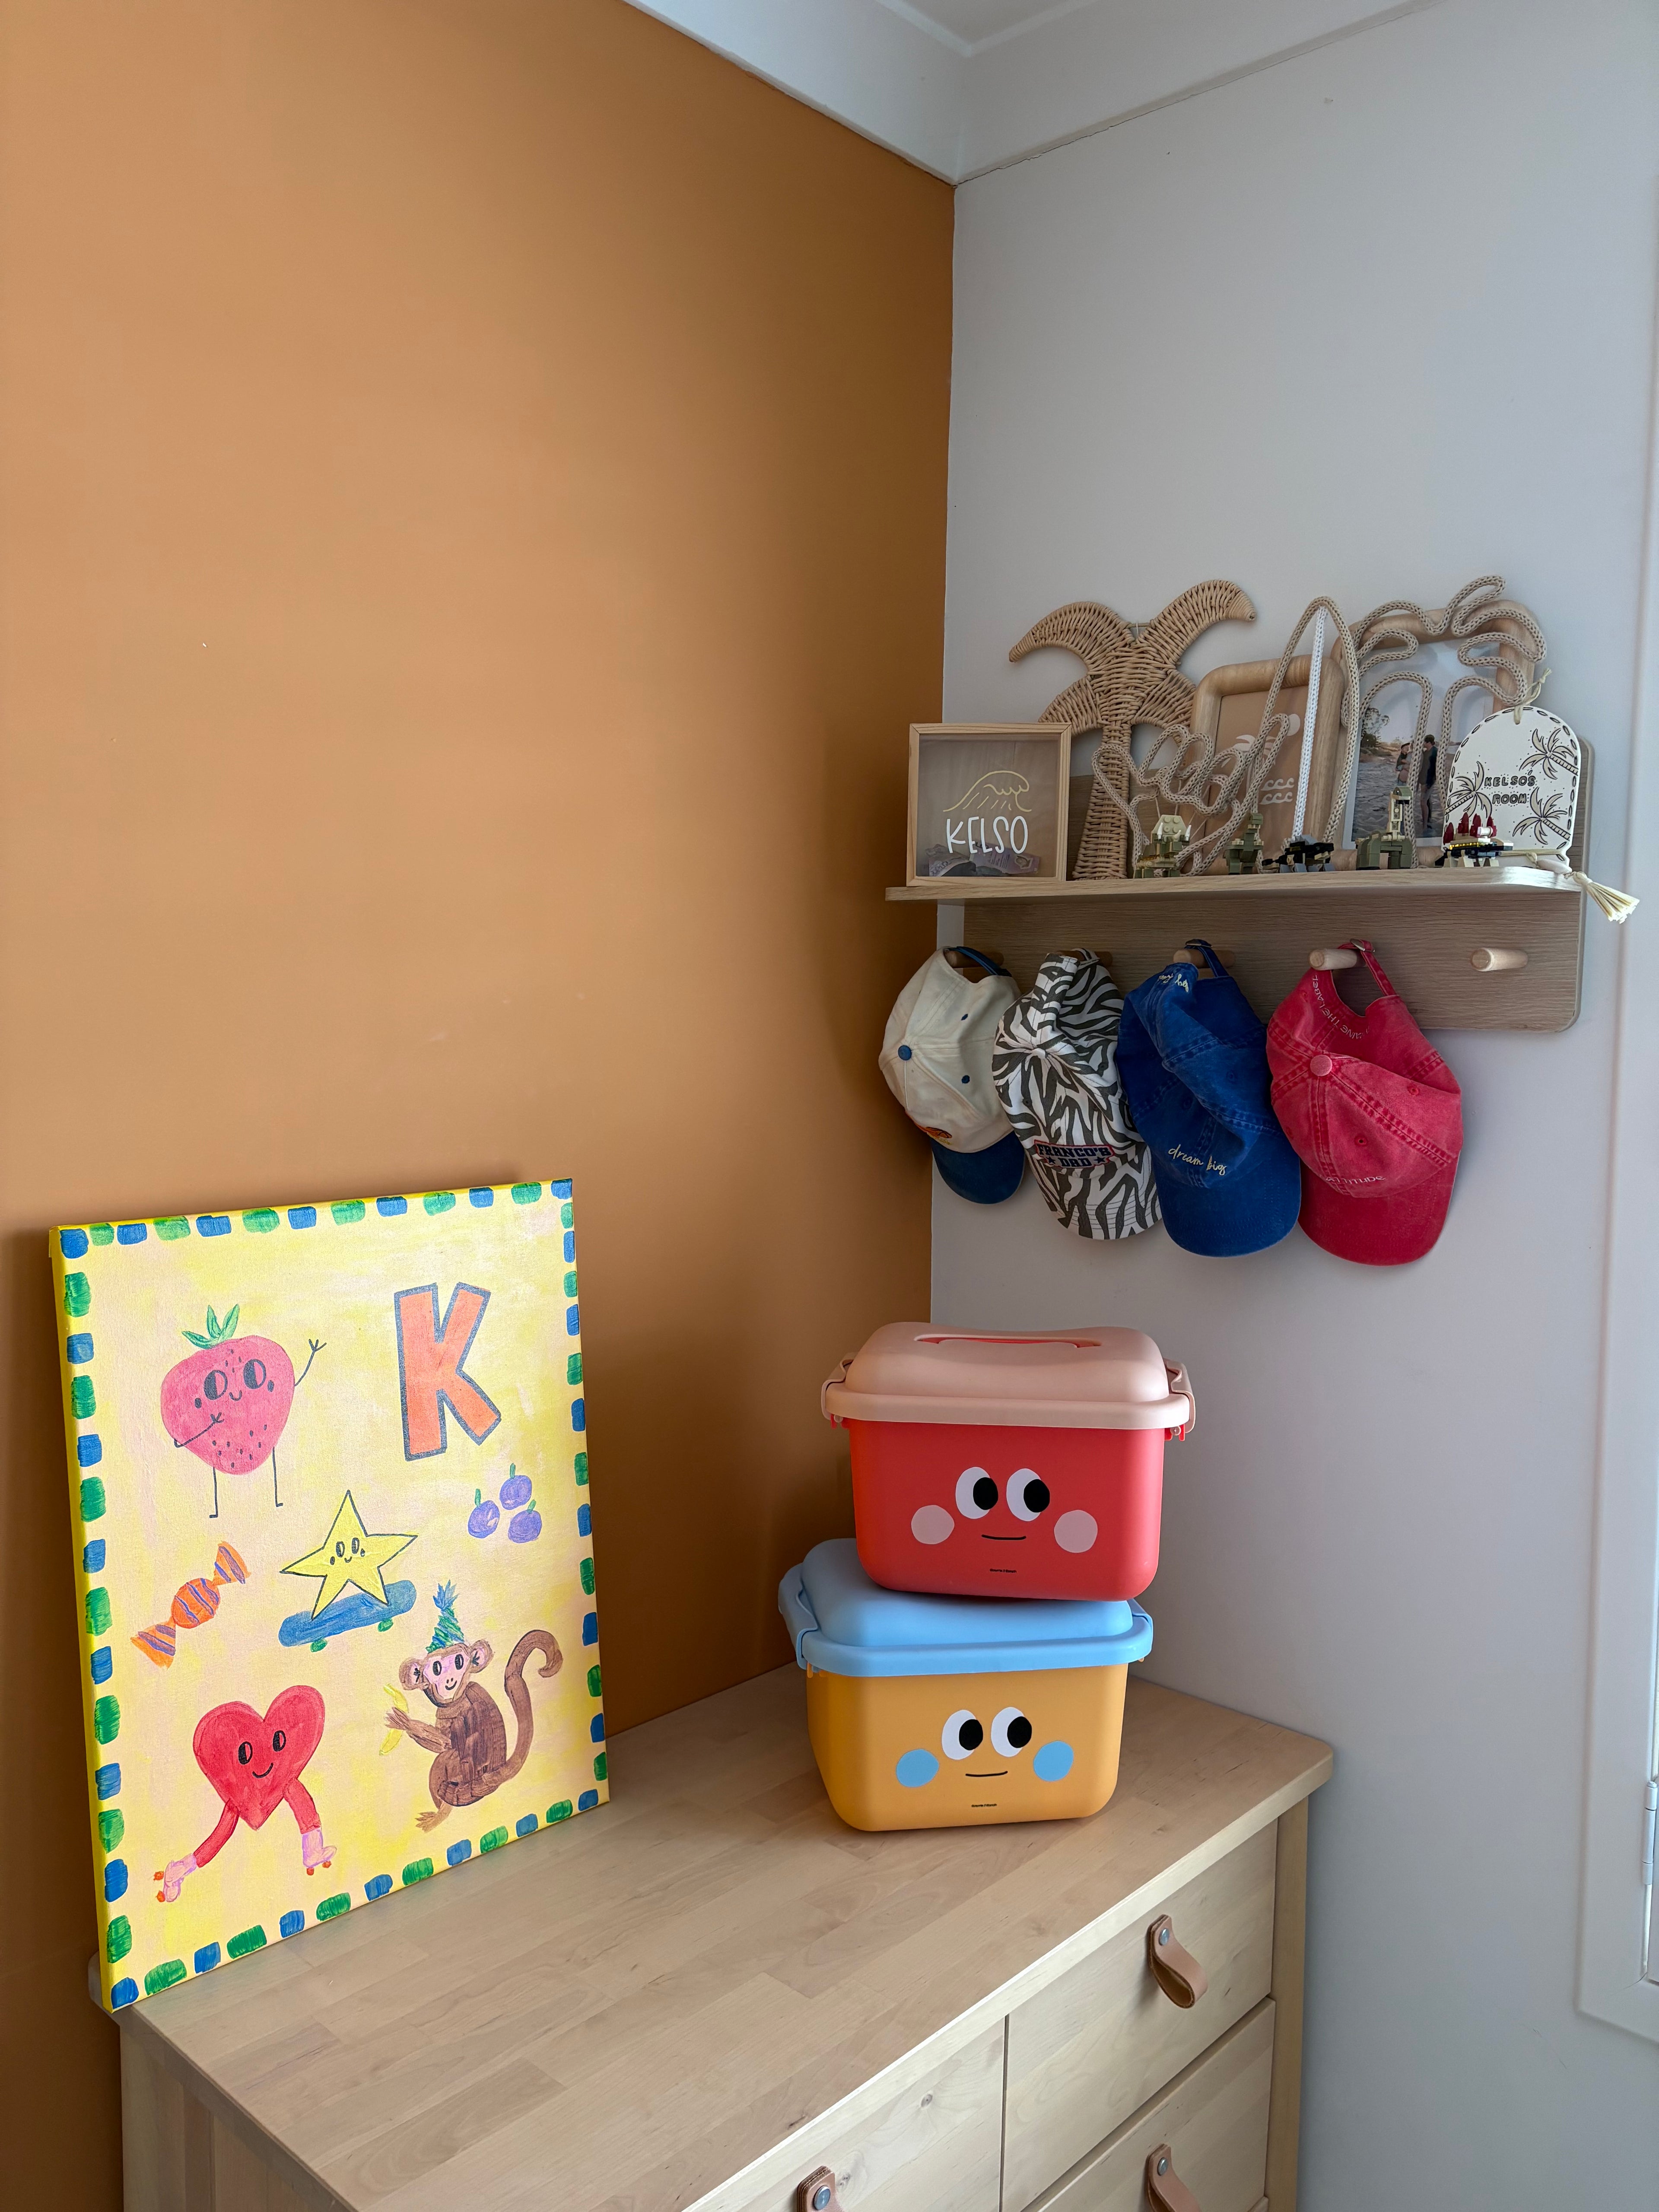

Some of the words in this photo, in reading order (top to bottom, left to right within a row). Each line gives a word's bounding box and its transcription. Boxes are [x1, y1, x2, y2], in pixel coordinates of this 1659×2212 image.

[1484, 769, 1536, 787] KELSO'S
[1492, 793, 1527, 804] ROOM
[947, 816, 1028, 854] KELSO
[1312, 975, 1326, 1008] LABEL
[1322, 1008, 1340, 1028] THE
[1036, 1144, 1112, 1158] FRANCO'S
[1168, 1144, 1204, 1165] dream
[1206, 1155, 1227, 1176] big
[1058, 1157, 1092, 1167] DAD
[1326, 1176, 1386, 1185] ATTITUDE
[394, 1282, 502, 1462] K
